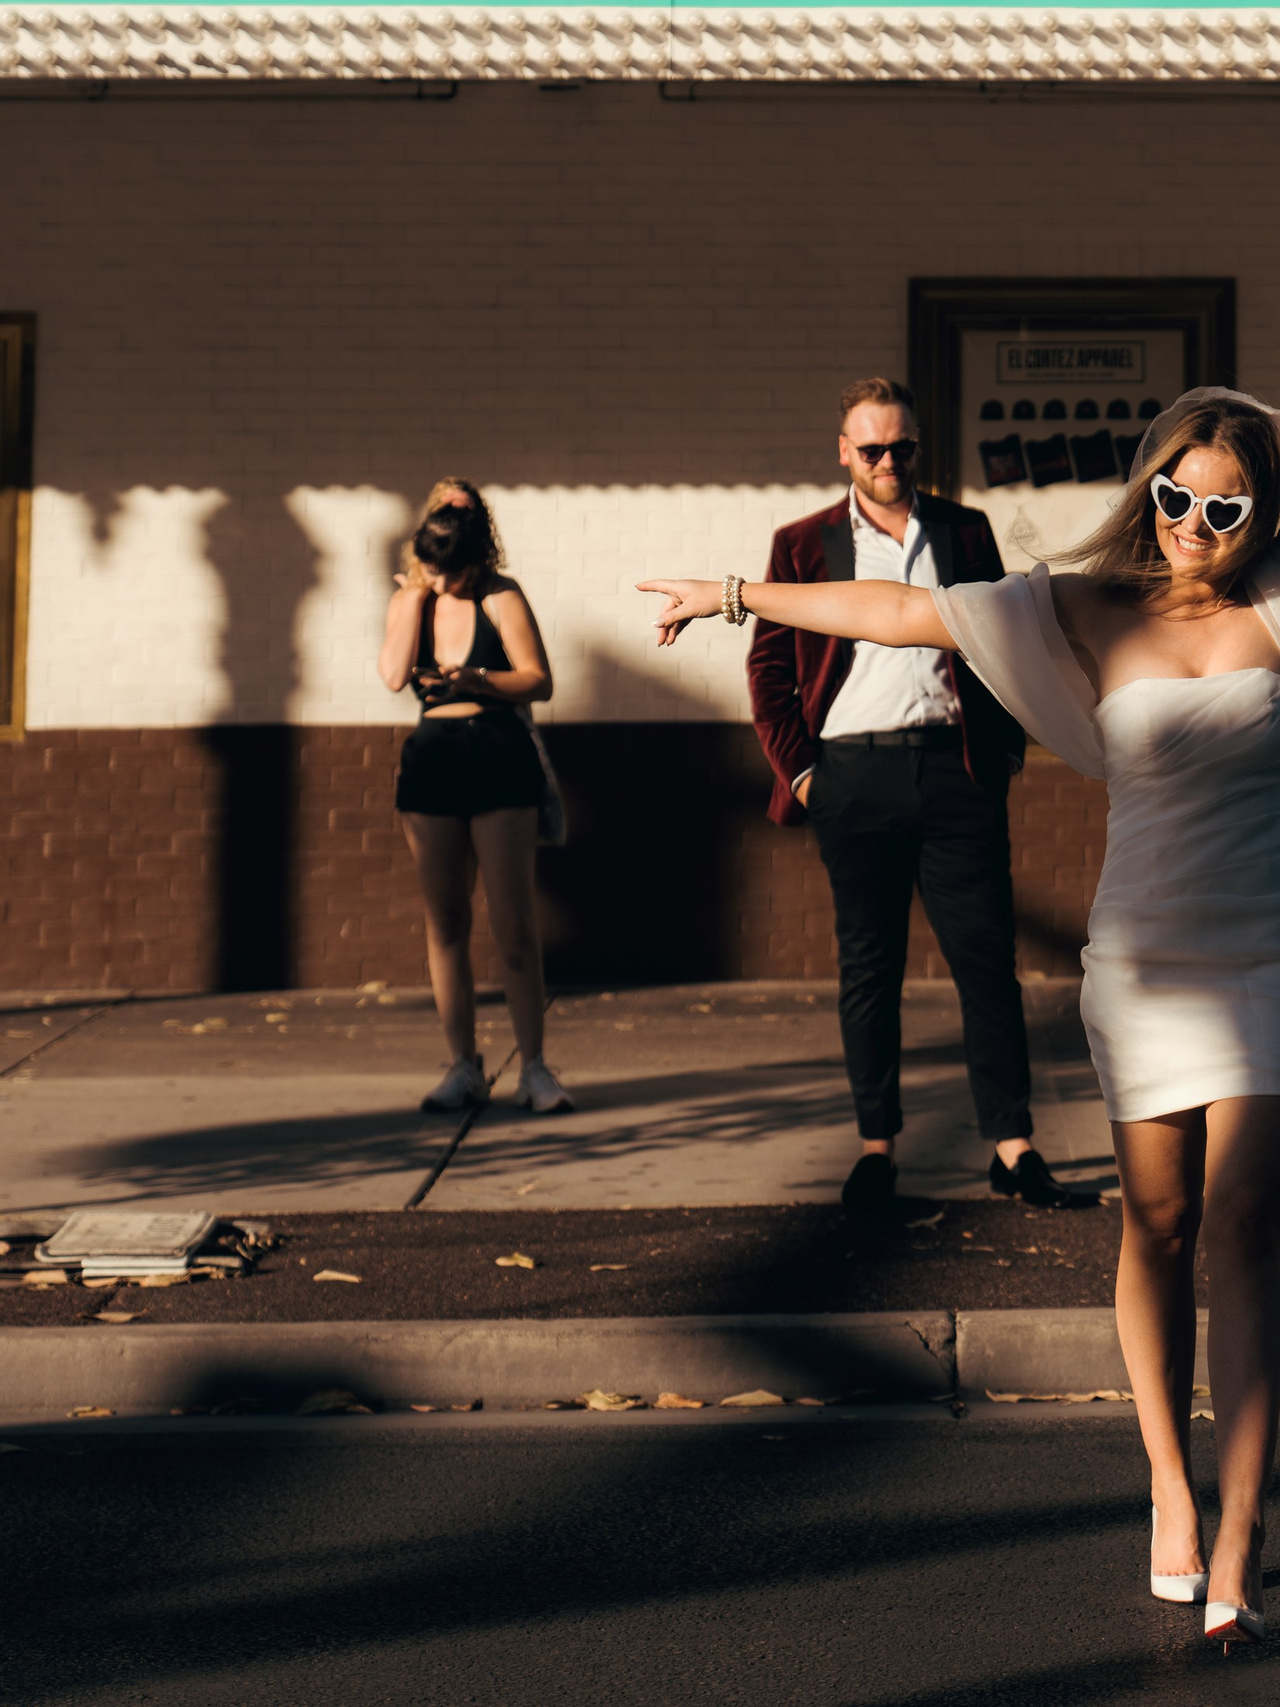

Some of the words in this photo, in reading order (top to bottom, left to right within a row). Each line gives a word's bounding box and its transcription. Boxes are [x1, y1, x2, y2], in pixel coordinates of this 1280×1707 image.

[1008, 348, 1022, 368] EL
[1025, 348, 1074, 369] CORTEZ
[1077, 348, 1134, 368] APPAREL
